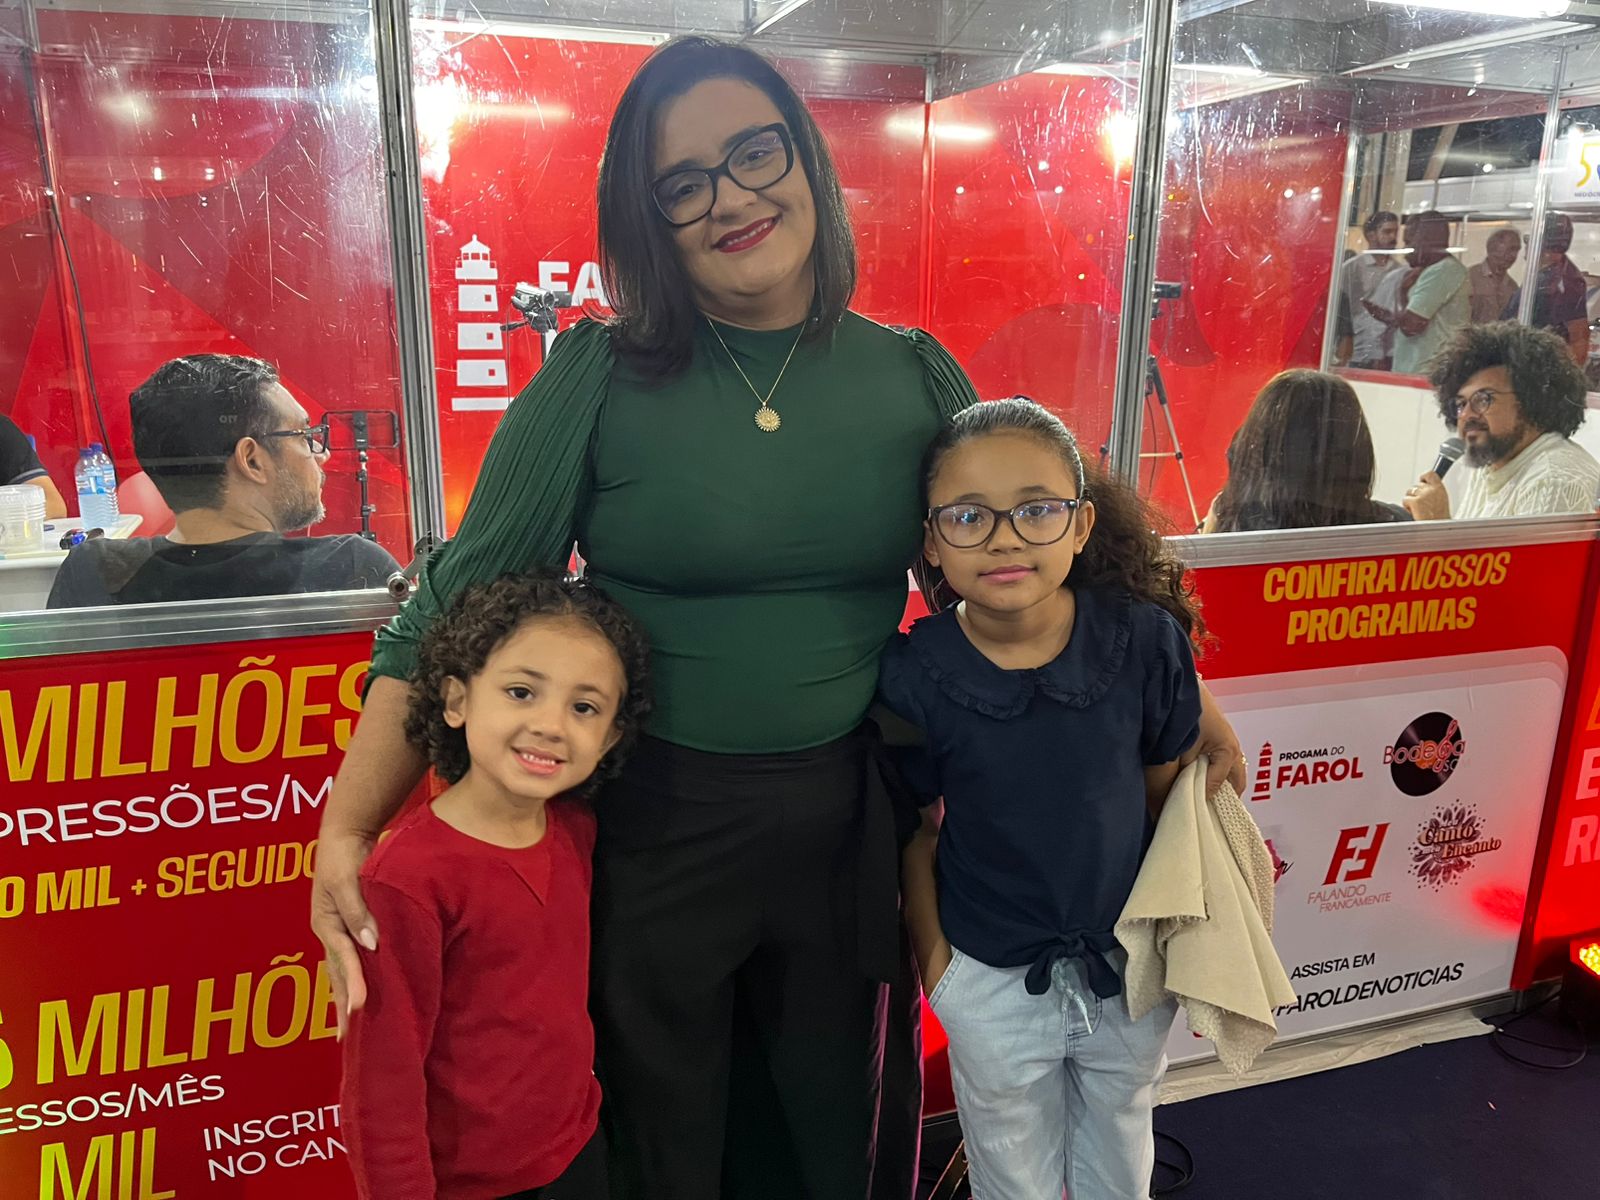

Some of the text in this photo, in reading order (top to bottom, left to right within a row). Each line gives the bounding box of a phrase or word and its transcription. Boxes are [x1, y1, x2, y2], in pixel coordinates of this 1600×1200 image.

[1263, 551, 1512, 603] CONFIRA NOSSOS
[1286, 596, 1477, 645] PROGRAMAS
[1279, 746, 1345, 762] PROGAMA DO
[1276, 757, 1364, 789] FAROL
[1417, 824, 1475, 847] Canto
[1440, 837, 1502, 860] Encanto
[36, 865, 121, 914] MIL
[131, 879, 147, 896] +
[1307, 884, 1367, 904] FALANDO
[1319, 892, 1392, 913] FRANCAMENTE
[1290, 952, 1376, 980] ASSISTA EM
[40, 1127, 176, 1200] MIL
[208, 1152, 267, 1182] NO
